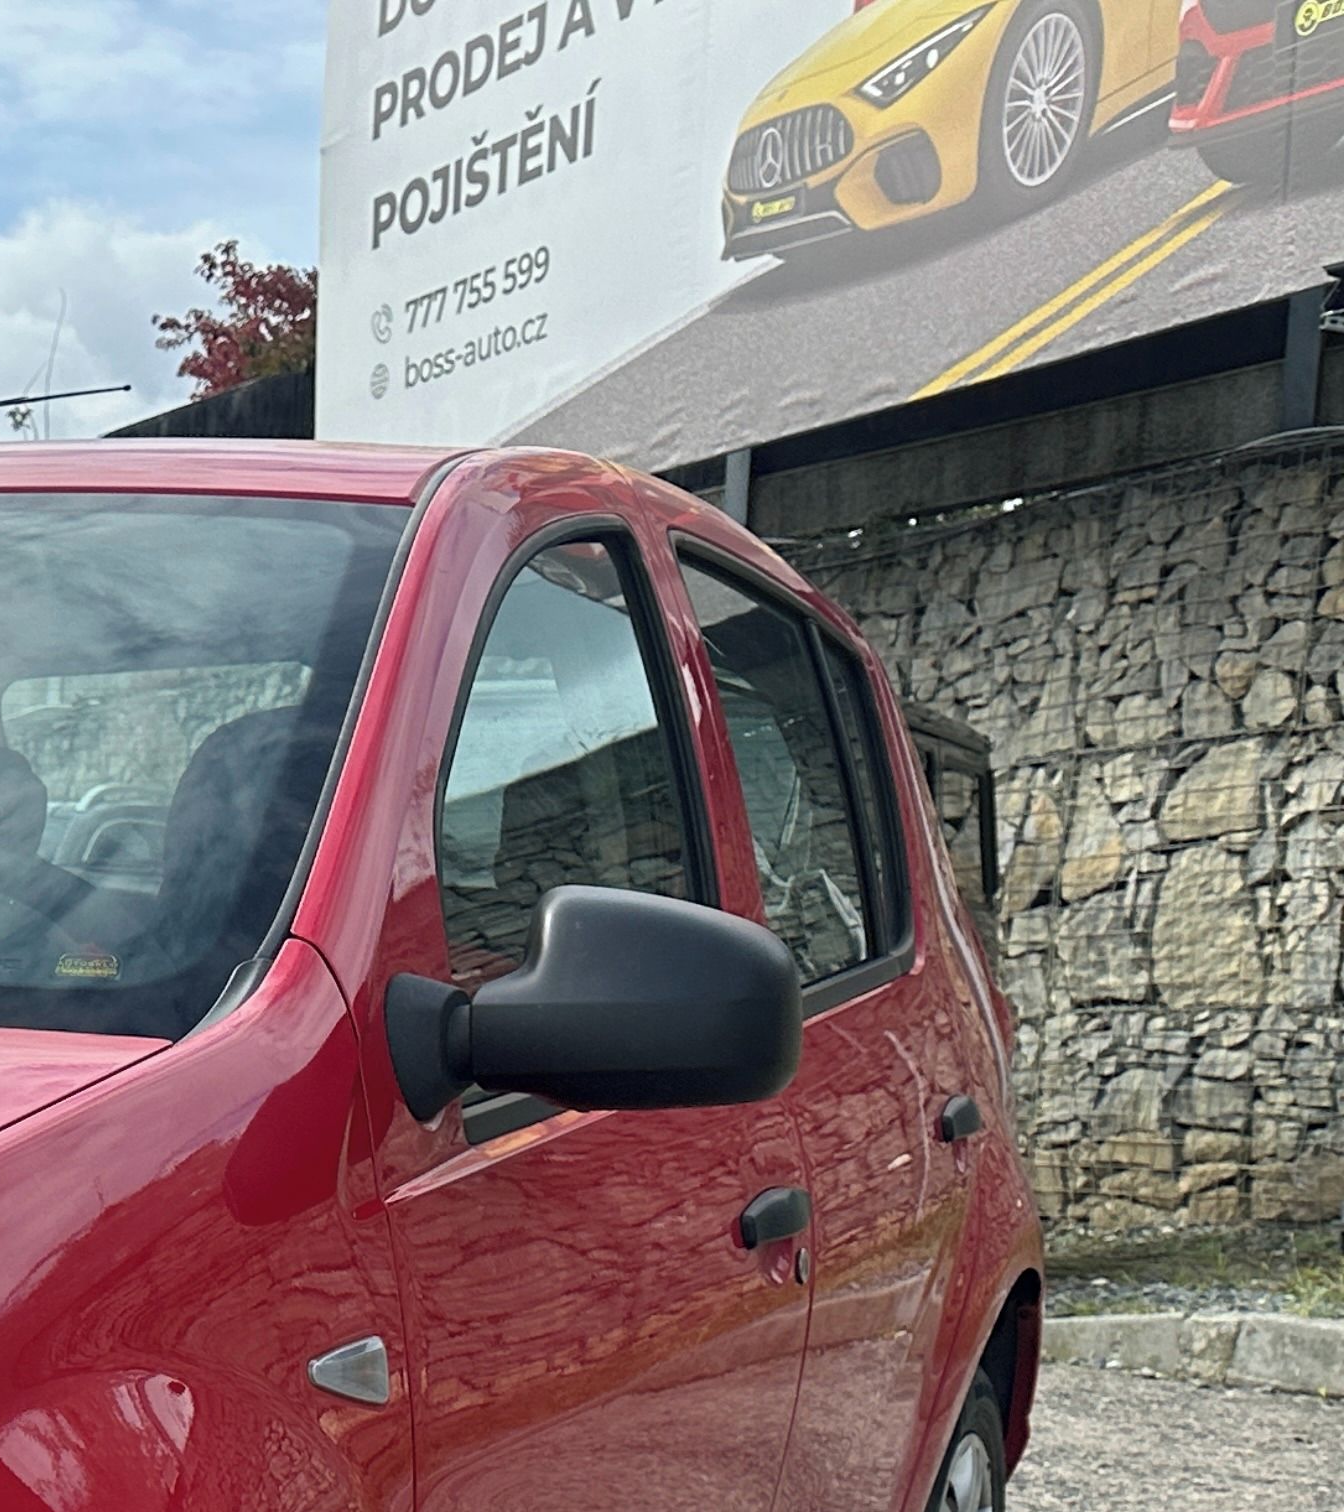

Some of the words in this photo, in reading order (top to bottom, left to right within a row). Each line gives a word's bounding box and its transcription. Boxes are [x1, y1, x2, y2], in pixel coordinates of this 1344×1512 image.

[372, 1, 548, 141] PRODEJ
[558, 0, 596, 50] A
[371, 77, 602, 251] POJIŠTĚNÍ
[404, 286, 448, 334] 777
[453, 265, 497, 315] 755
[502, 246, 550, 295] 599
[405, 312, 549, 389] boss-auto.cz
